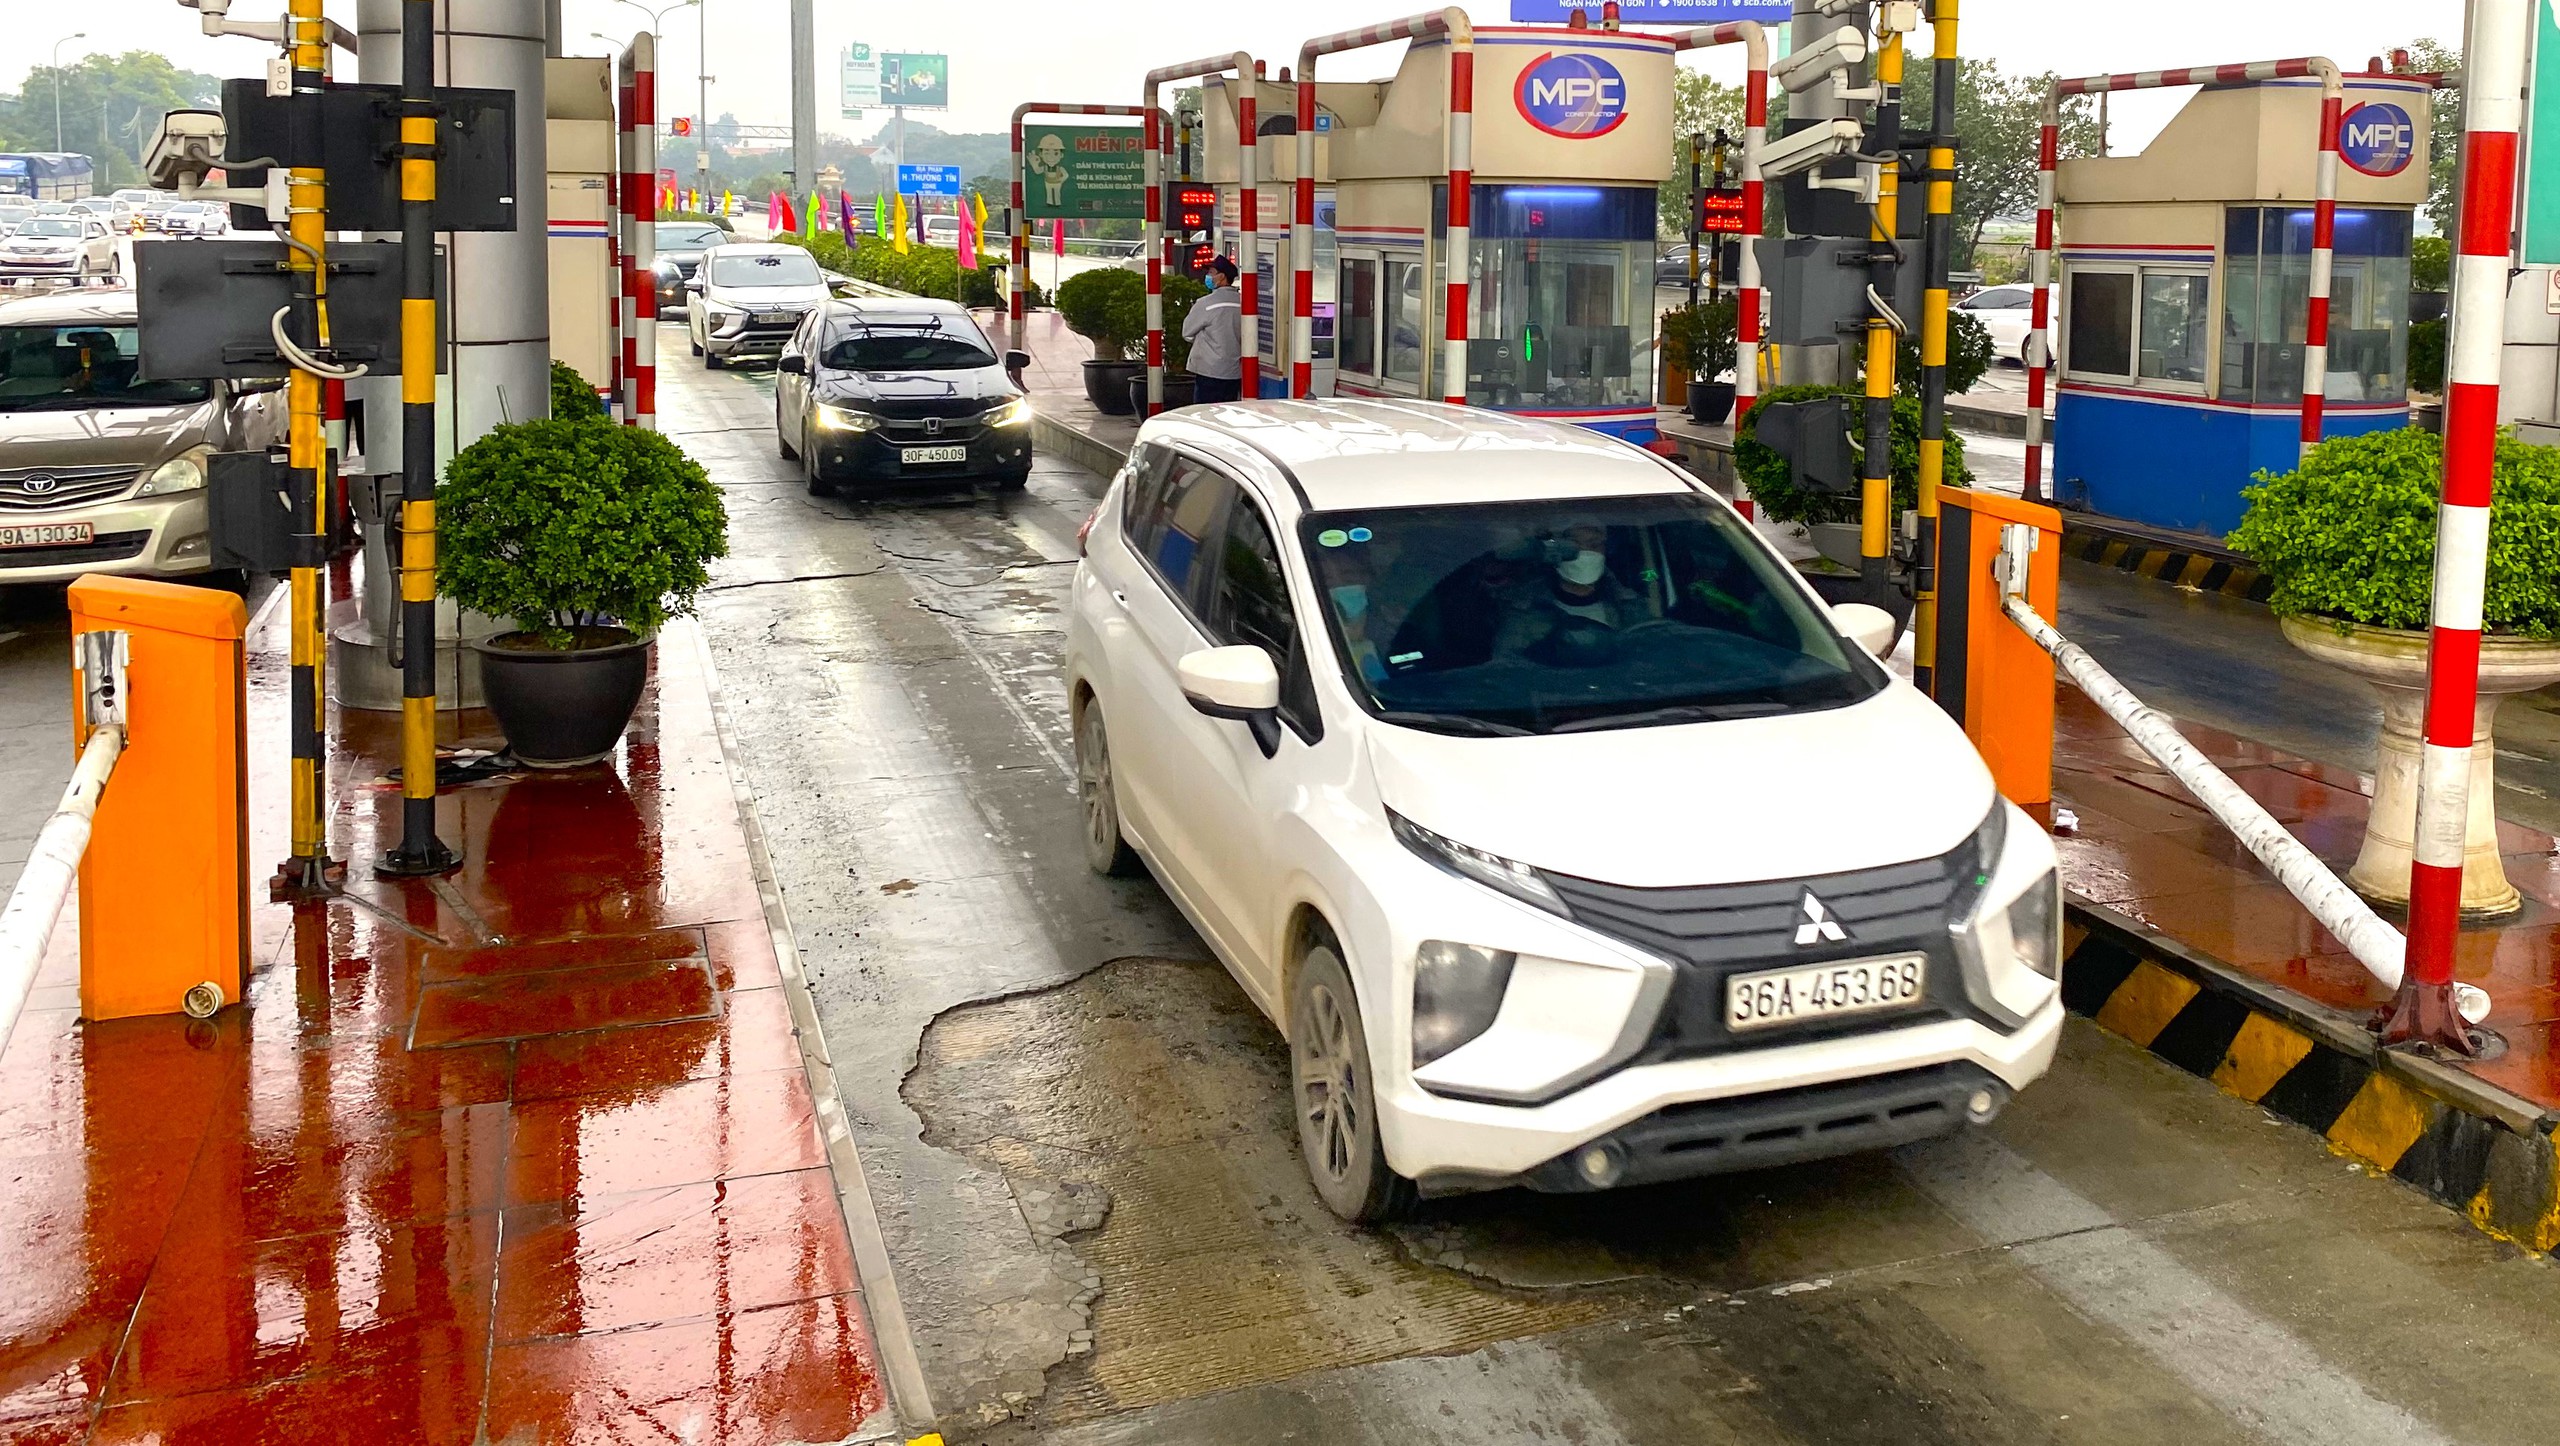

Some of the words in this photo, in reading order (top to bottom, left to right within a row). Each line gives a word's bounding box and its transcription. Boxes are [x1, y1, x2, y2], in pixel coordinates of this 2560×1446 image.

[1532, 78, 1620, 106] MPC
[2347, 123, 2411, 149] MPC
[903, 448, 964, 462] 30F-450.09
[0, 525, 89, 545] 9A-130.34
[1735, 961, 1919, 1021] 36A-453.68
